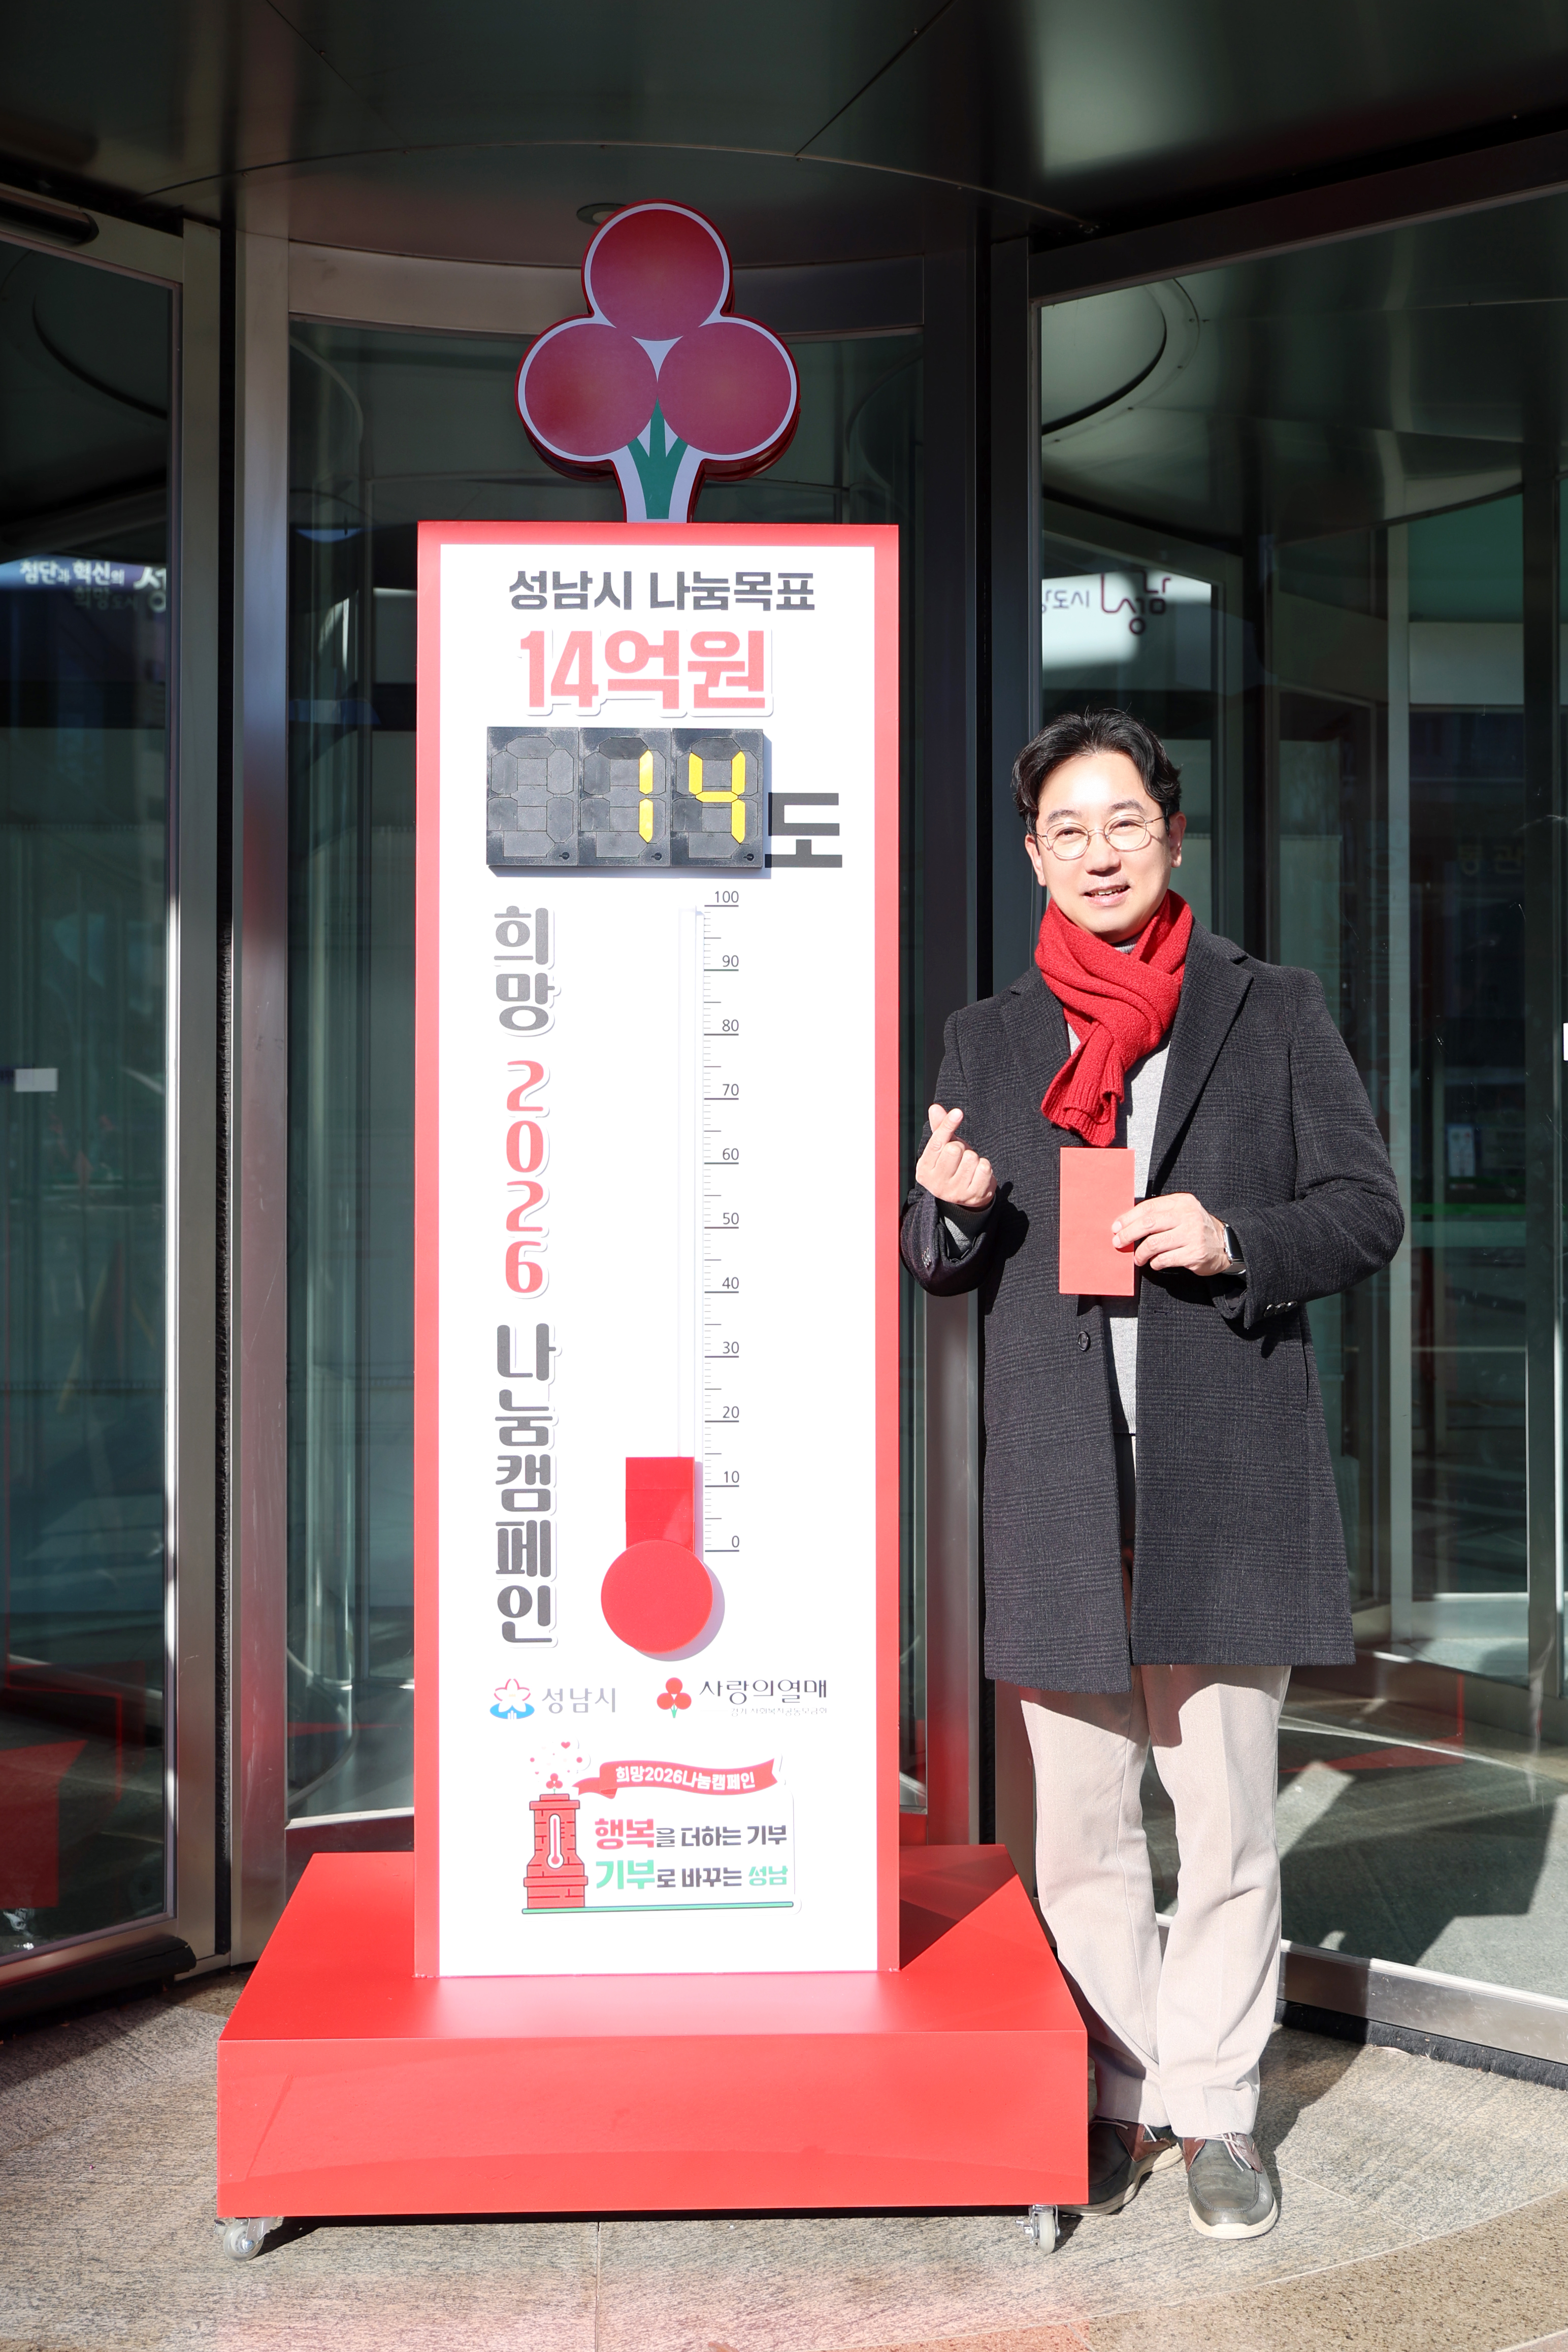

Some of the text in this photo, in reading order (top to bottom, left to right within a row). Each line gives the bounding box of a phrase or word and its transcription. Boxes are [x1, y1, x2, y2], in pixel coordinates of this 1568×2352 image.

[20, 560, 71, 585] 첨단과
[73, 561, 125, 586] 혁신의
[509, 570, 815, 611] 성남시 나눔목표
[520, 630, 766, 709] 14억원
[638, 749, 843, 868] 14 도
[714, 890, 739, 903] 100
[722, 955, 740, 968] 90
[722, 1019, 740, 1032] 80
[722, 1083, 740, 1097] 70
[722, 1148, 740, 1161] 60
[722, 1212, 740, 1226] 50
[494, 905, 557, 1643] 희망 2026 나눔캠페인
[722, 1277, 740, 1290] 40
[722, 1341, 740, 1355] 30
[722, 1406, 740, 1419] 20
[722, 1470, 740, 1484] 10
[731, 1535, 740, 1548] 0
[699, 1679, 827, 1705] 사랑의열매
[542, 1687, 615, 1714] 성남시
[615, 1766, 756, 1791] 희망2026나눔캠페인
[594, 1818, 788, 1850] 행복을 더하는 기부
[596, 1859, 789, 1889] 기부로 바꾸는 성남
